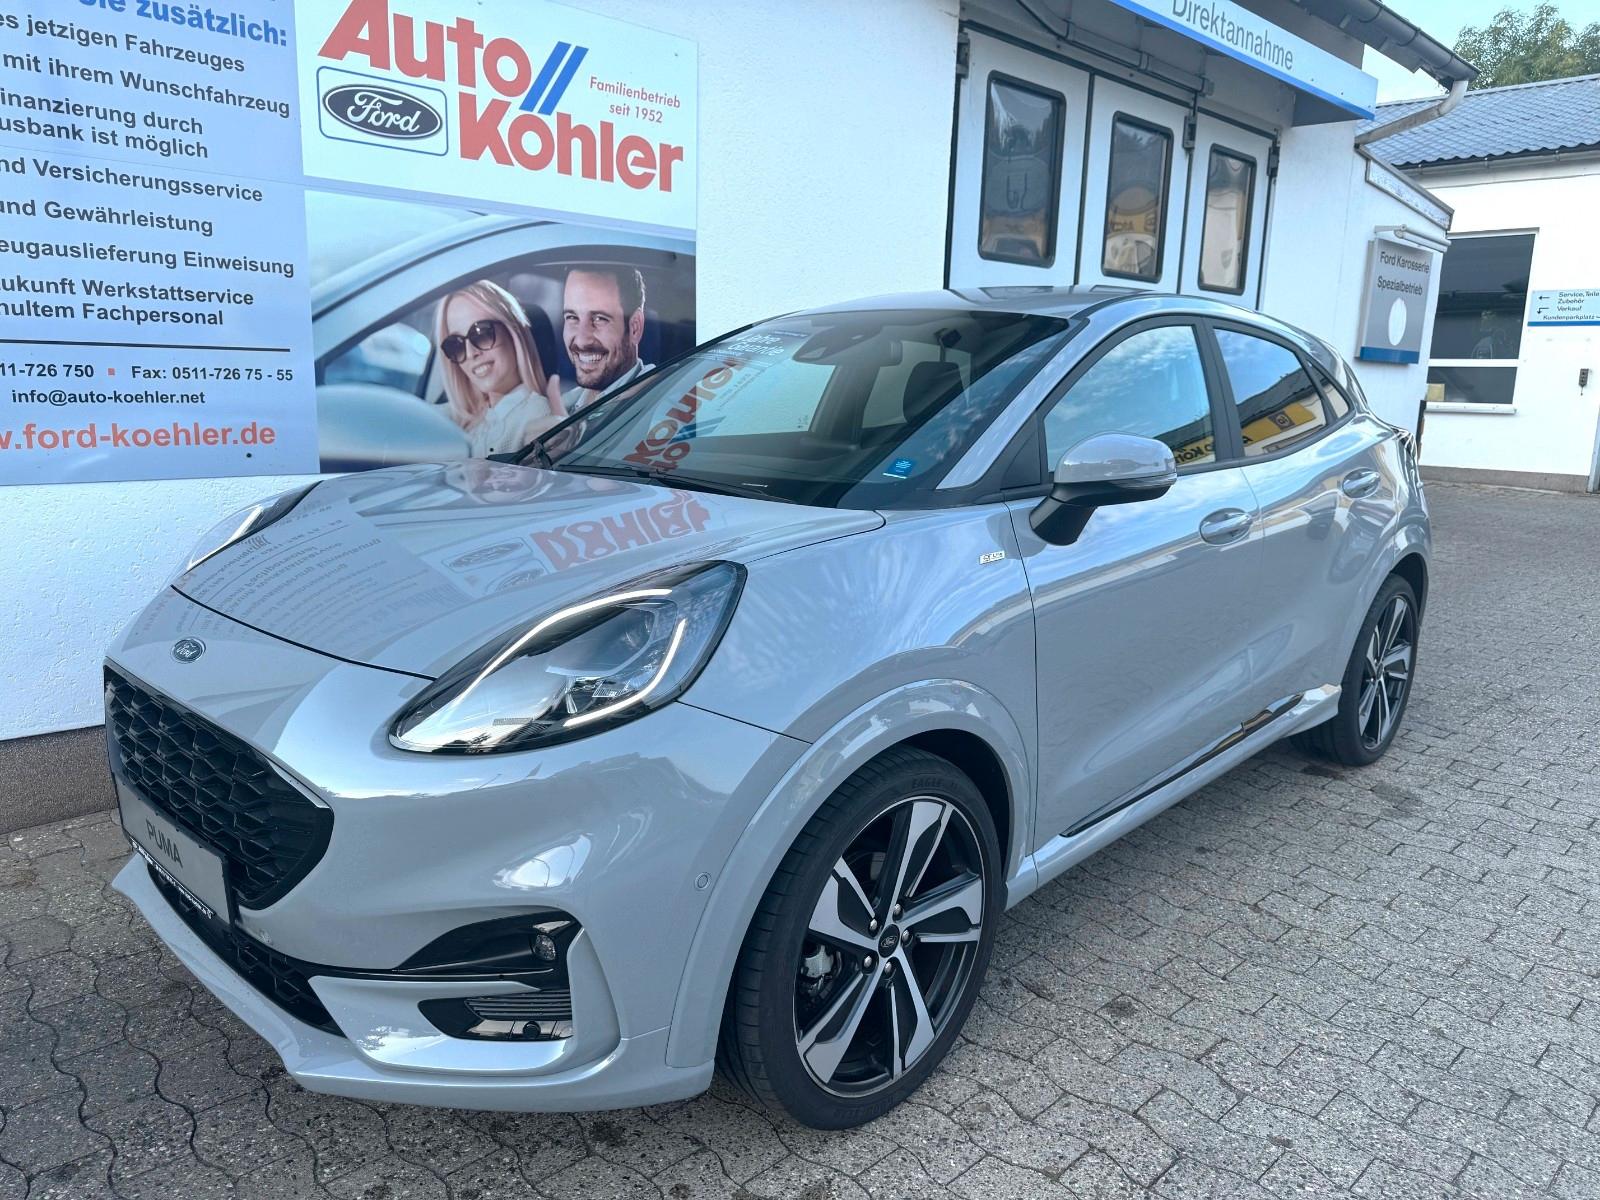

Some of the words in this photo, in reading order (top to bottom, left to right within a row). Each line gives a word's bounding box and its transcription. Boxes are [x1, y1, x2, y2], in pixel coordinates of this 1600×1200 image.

[135, 0, 287, 47] zusätzlich:
[1171, 0, 1294, 71] Direktannahme
[26, 14, 118, 49] jetzigen
[125, 34, 245, 72] Fahrzeuges
[317, 0, 532, 98] Auto
[3, 53, 42, 73] mit
[48, 58, 113, 86] ihrem
[120, 71, 290, 119] Wunschfahrzeug
[589, 76, 681, 109] Familienbetrieb
[143, 111, 203, 135] durch
[346, 91, 422, 132] Ford
[609, 103, 630, 117] seit
[635, 106, 663, 123] 1952
[91, 127, 118, 147] ist
[125, 134, 208, 159] möglich
[33, 158, 263, 202] Versicherungsservice
[44, 201, 214, 237] Gewährleistung
[184, 252, 295, 278] Einweisung
[1380, 251, 1396, 266] Ford
[1396, 255, 1430, 274] Karosserie
[82, 279, 254, 306] Werkstattservice
[1377, 275, 1423, 296] Spezialbetrieb
[83, 303, 223, 325] Fachpersonal
[63, 364, 95, 378] 750
[131, 366, 167, 380] Fax:
[172, 367, 240, 381] 0511-726
[245, 368, 262, 381] 75
[276, 369, 293, 382] 55
[12, 390, 206, 407] info@auto-koehler.net
[145, 817, 183, 868] PUMA
